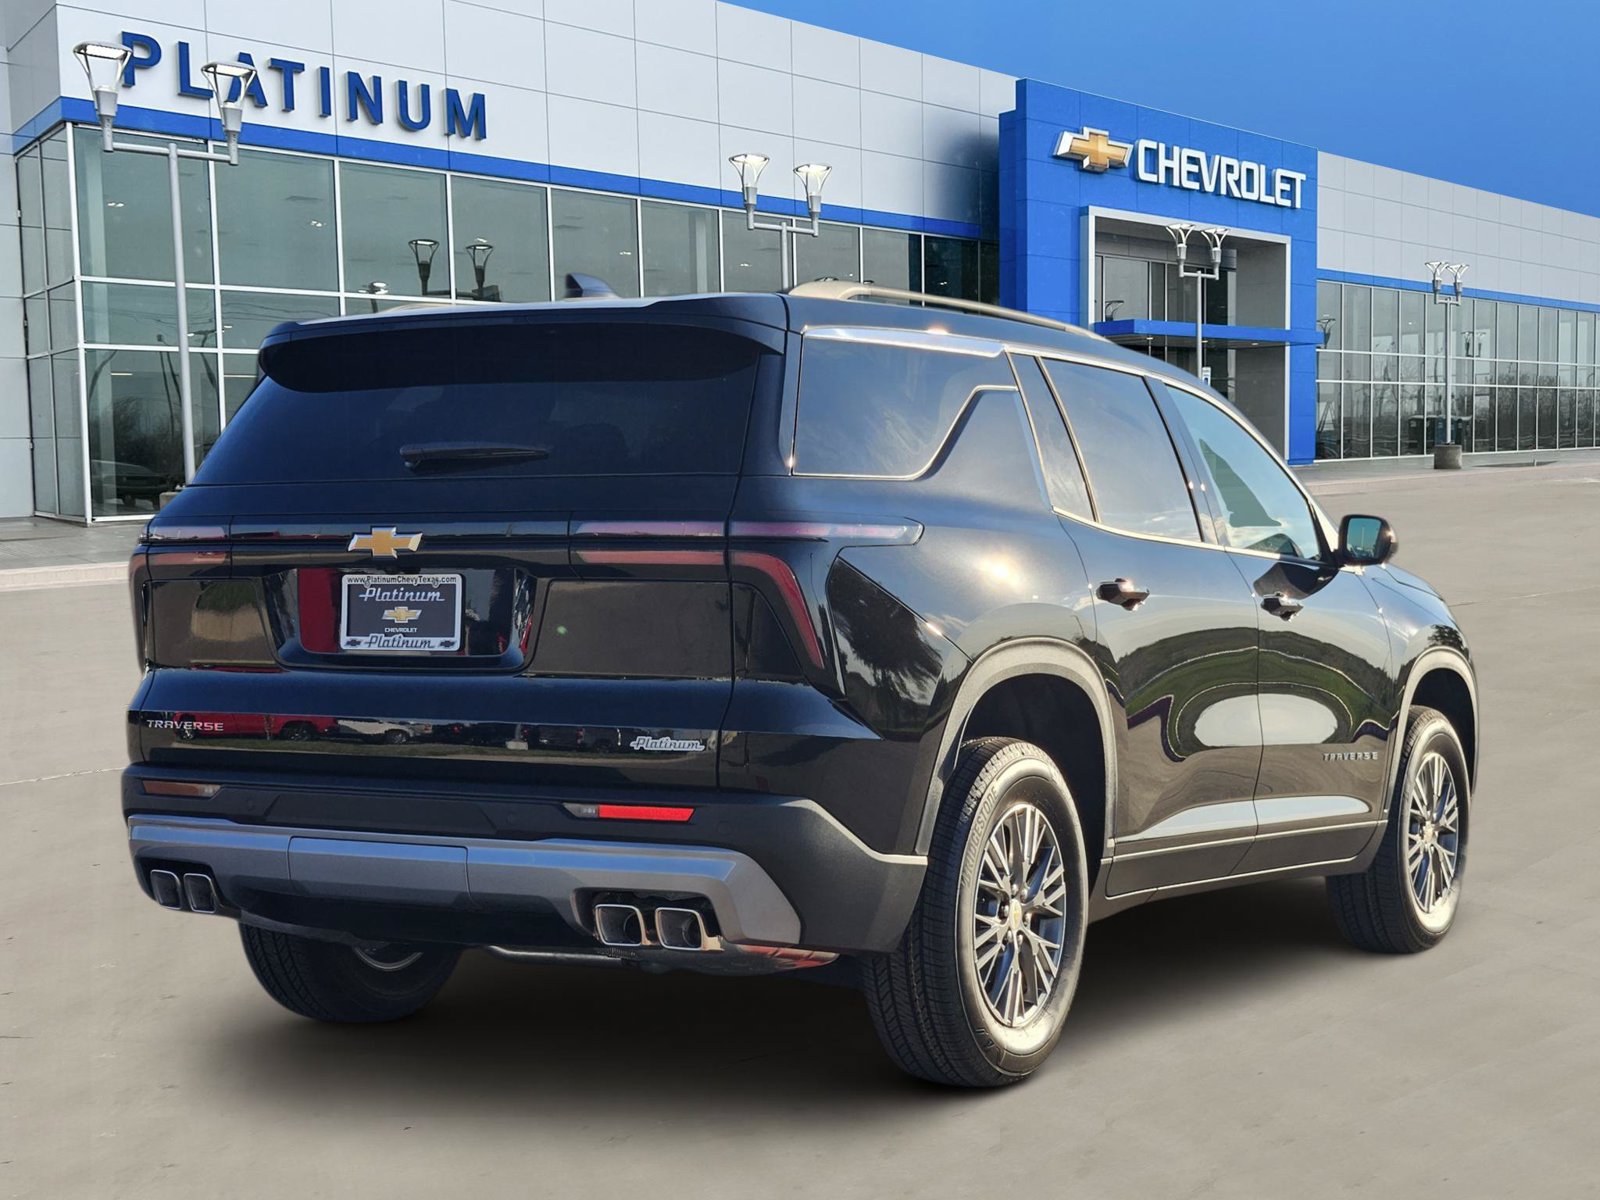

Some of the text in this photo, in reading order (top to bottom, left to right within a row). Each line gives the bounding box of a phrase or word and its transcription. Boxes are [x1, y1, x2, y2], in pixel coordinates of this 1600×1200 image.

[121, 31, 487, 141] PLATINUM
[1135, 138, 1306, 209] CHEVROLET
[347, 575, 457, 586] www.PlatinumChevyTexas.com
[359, 587, 445, 602] Platinum
[364, 634, 436, 649] Platinum
[146, 719, 224, 731] TRAVERSE
[630, 736, 705, 751] Platinum
[1322, 751, 1379, 761] TRAVERSE
